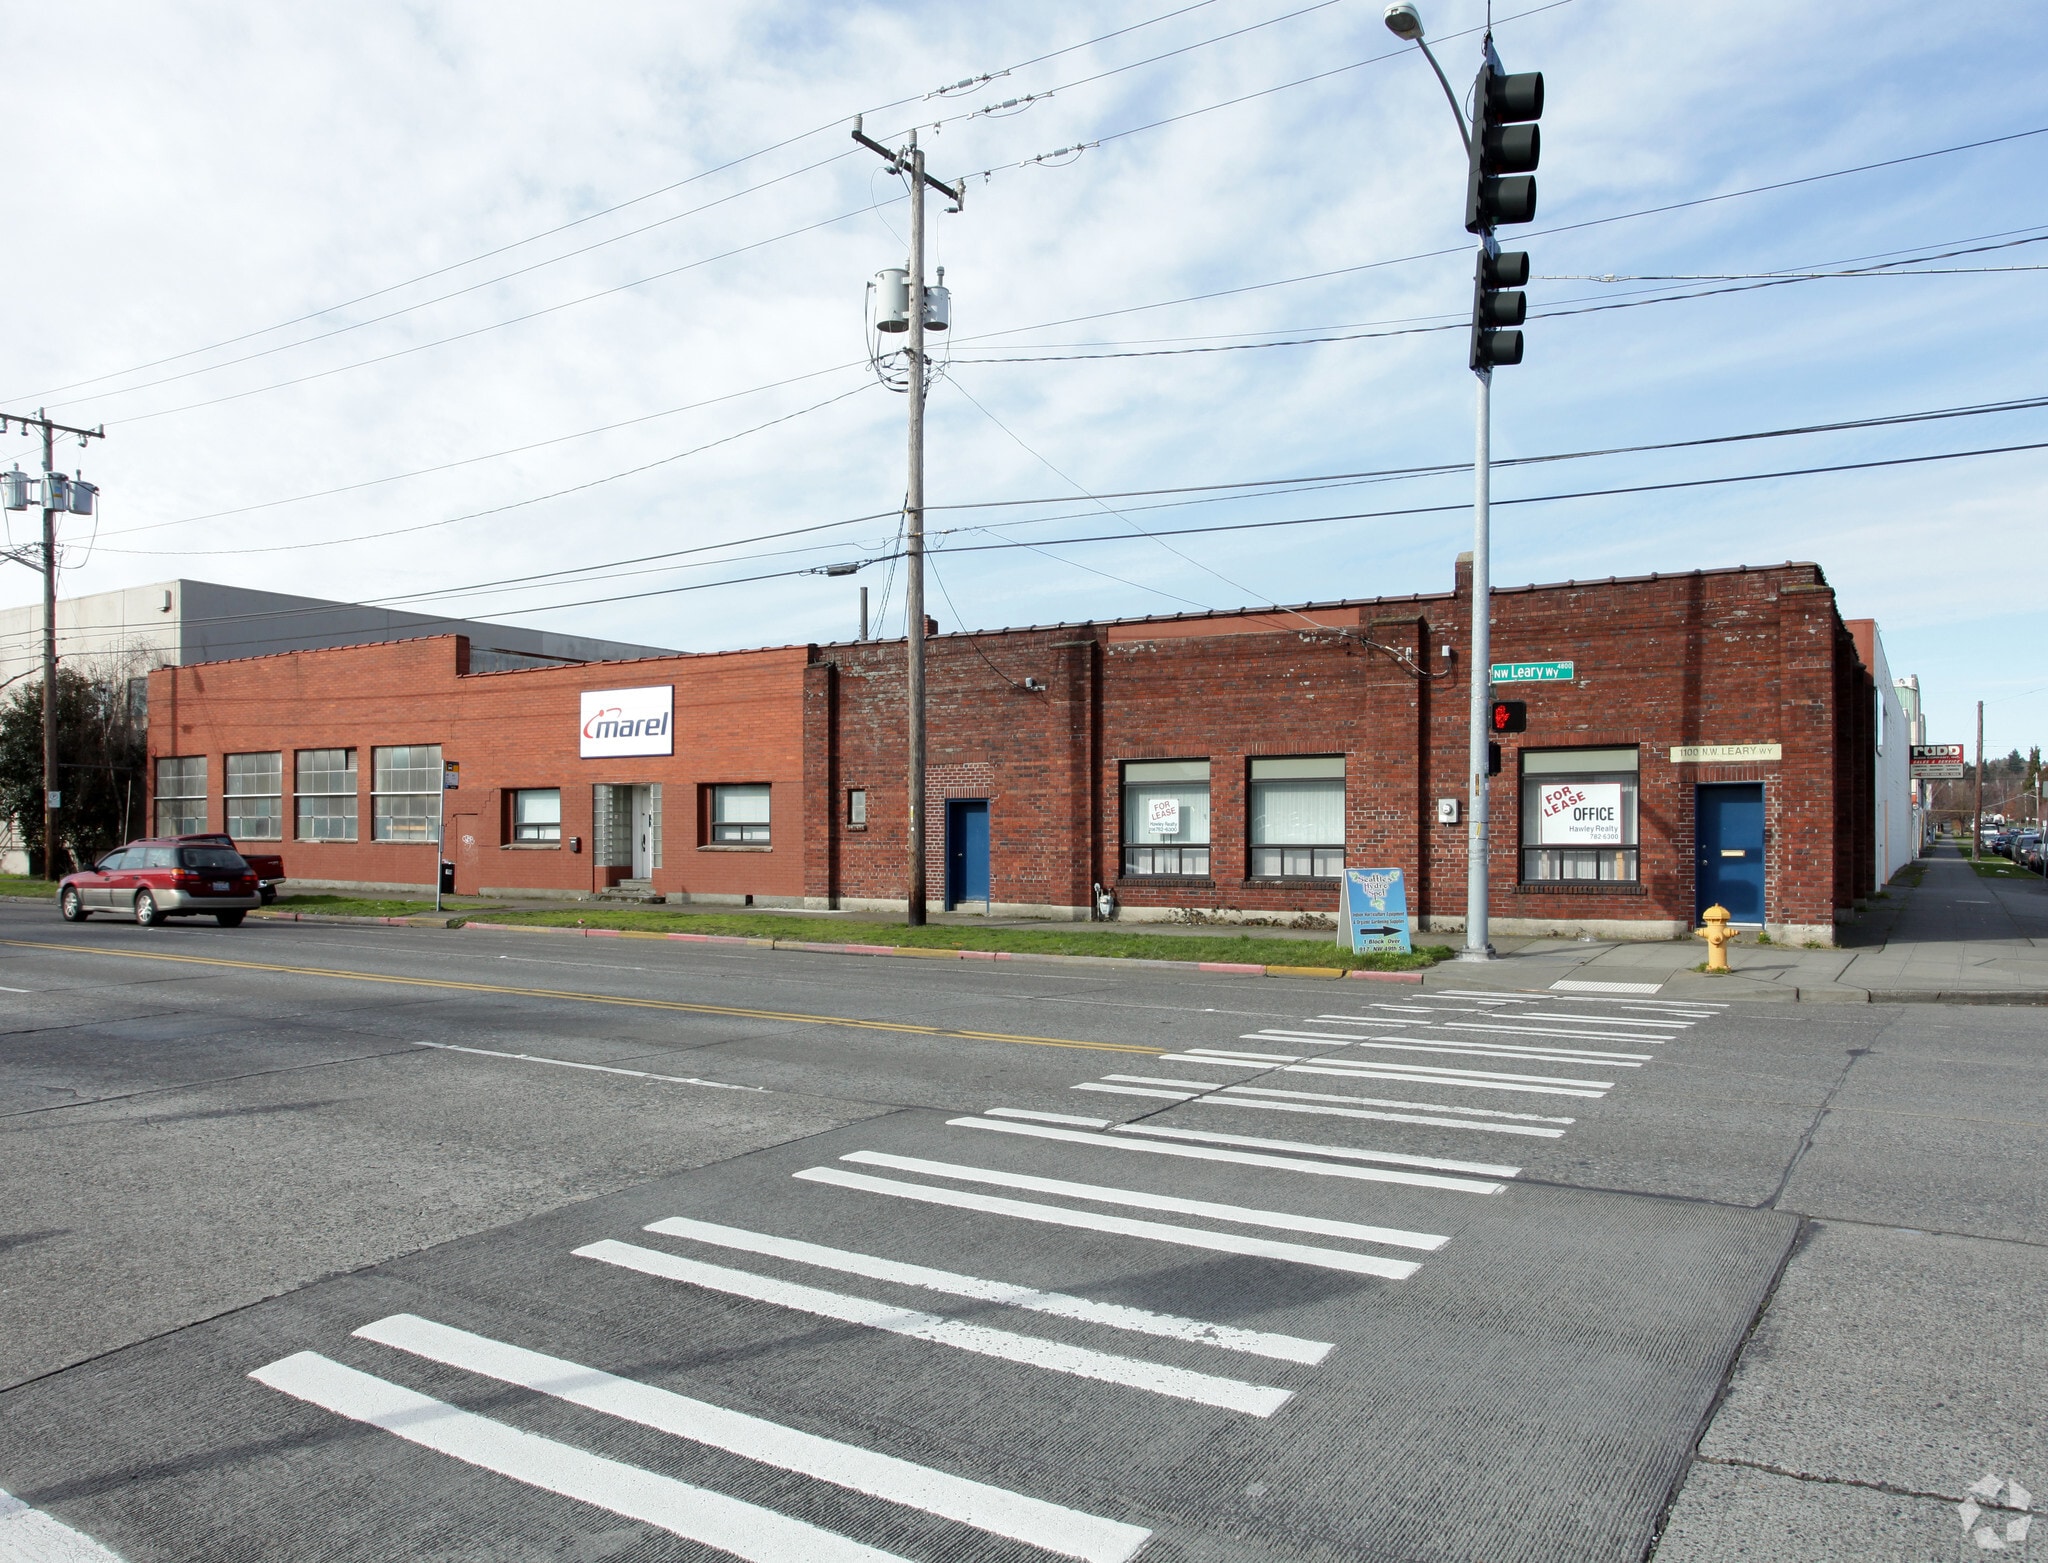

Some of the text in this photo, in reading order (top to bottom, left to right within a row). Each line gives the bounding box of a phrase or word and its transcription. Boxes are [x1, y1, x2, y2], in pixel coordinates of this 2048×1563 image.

[1494, 665, 1559, 680] NW Leary Wy
[1557, 662, 1572, 670] 4800
[595, 711, 669, 739] marel
[1680, 746, 1773, 757] 1100 N.W. LEARY WY
[1545, 786, 1572, 805] FOR
[1154, 801, 1170, 811] FOR
[1543, 791, 1586, 818] LEASE
[1152, 807, 1176, 820] LEASE
[1573, 806, 1615, 821] OFFICE
[1569, 824, 1619, 834] Hawley Realty
